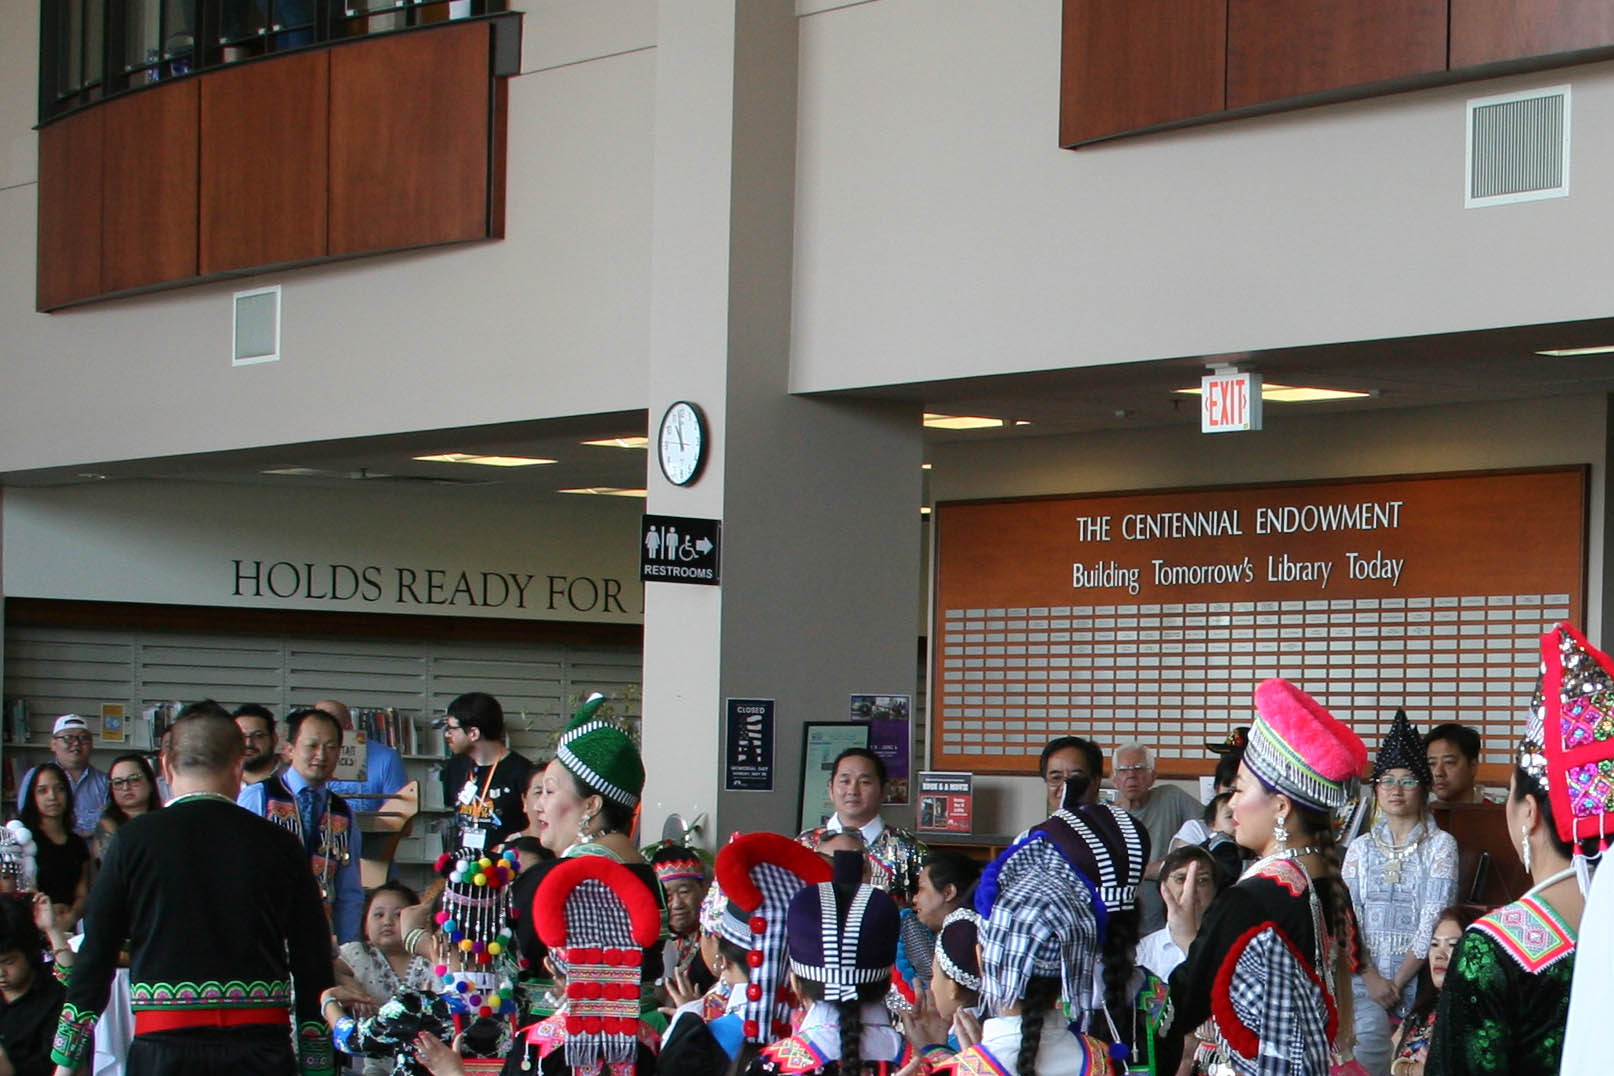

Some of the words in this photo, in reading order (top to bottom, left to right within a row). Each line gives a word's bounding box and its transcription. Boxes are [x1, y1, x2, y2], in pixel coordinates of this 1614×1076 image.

[1209, 379, 1245, 425] EXIT
[1076, 515, 1111, 542] THE
[1121, 509, 1243, 540] CENTENNIAL
[1255, 501, 1403, 534] ENDOWMENT
[231, 559, 382, 603] HOLDS
[395, 567, 536, 609] READY
[546, 575, 628, 614] FOR
[644, 564, 713, 579] RESTROOMS
[1072, 560, 1140, 595] Building
[1151, 556, 1254, 585] Tomorrow's
[1267, 553, 1333, 589] Library
[1345, 550, 1404, 587] Today
[737, 706, 766, 714] CLOSED
